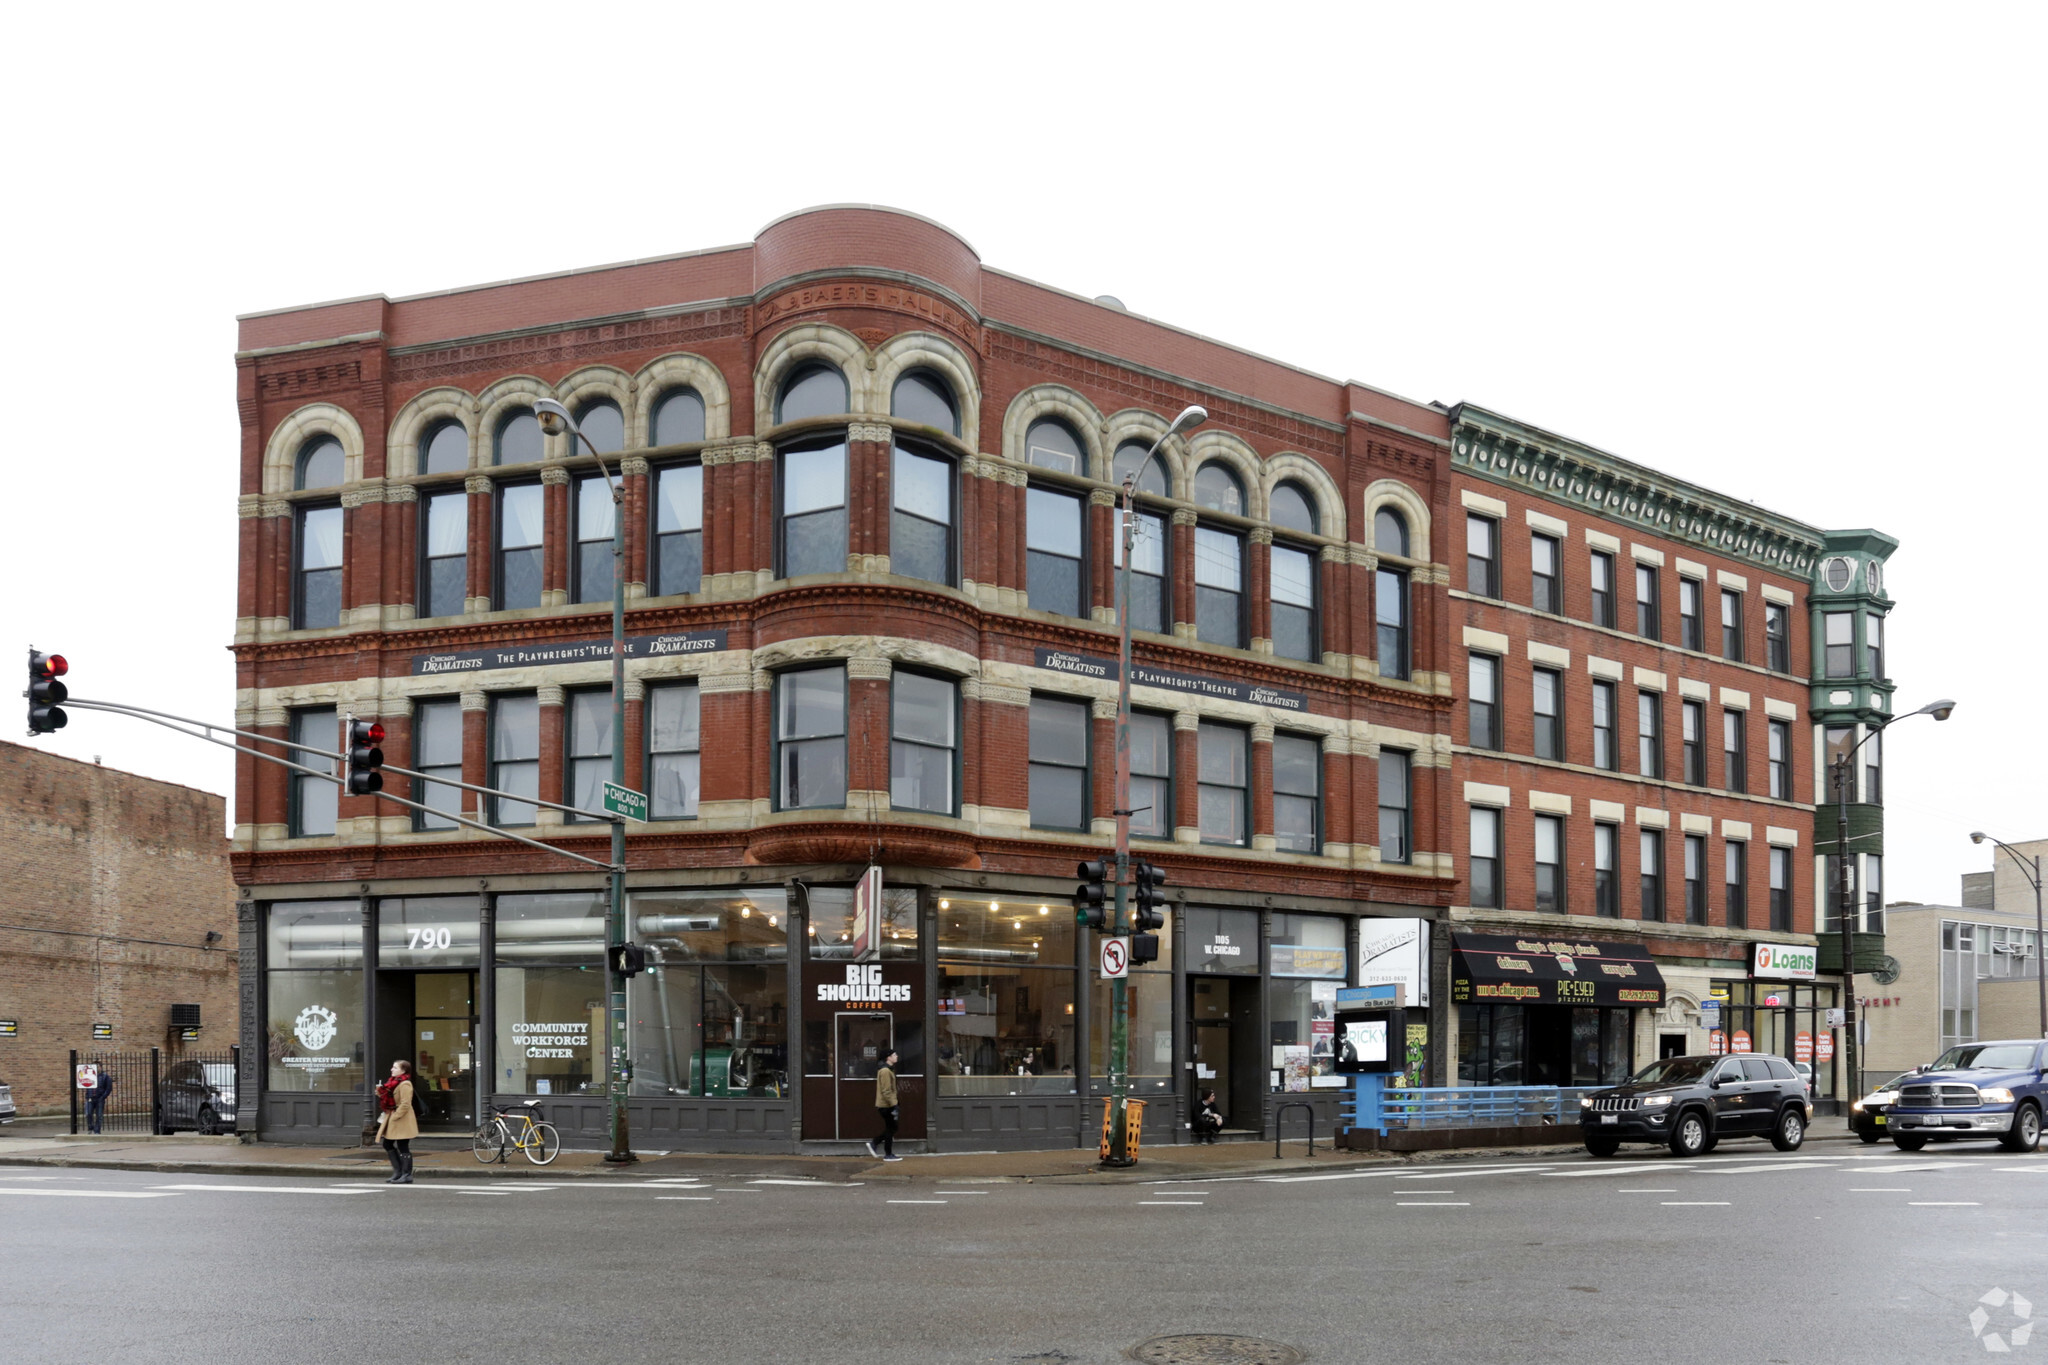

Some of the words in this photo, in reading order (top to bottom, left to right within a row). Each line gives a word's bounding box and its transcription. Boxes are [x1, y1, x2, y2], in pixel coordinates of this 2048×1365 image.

[803, 286, 878, 305] BAER'S
[889, 294, 941, 318] HALL
[497, 654, 515, 663] THE
[590, 644, 634, 655] THEARE
[649, 639, 716, 654] DRAMATISTS
[1054, 652, 1080, 662] CHICAGO
[422, 659, 483, 672] DRAMATISTS
[1045, 655, 1106, 676] DRAMATISTS
[1201, 681, 1237, 696] THEATRE
[1256, 688, 1278, 697] CHICAGO
[1249, 691, 1300, 709] DRAMATISTS
[610, 788, 639, 807] CHICAGO
[407, 928, 450, 949] 790
[1215, 935, 1230, 945] 1105
[1362, 929, 1417, 960] DRAMATISTS
[1204, 945, 1213, 954] W.
[1213, 945, 1241, 956] CHICAGO
[1496, 956, 1533, 973] delivery
[1772, 949, 1814, 970] Loans
[846, 965, 882, 985] BIG
[817, 984, 911, 1001] SHOULDERS
[511, 1023, 589, 1033] COMMUNITY
[511, 1036, 589, 1046] WORKFORCE
[1349, 1029, 1387, 1044] RICKY
[526, 1049, 574, 1058] CENTER
